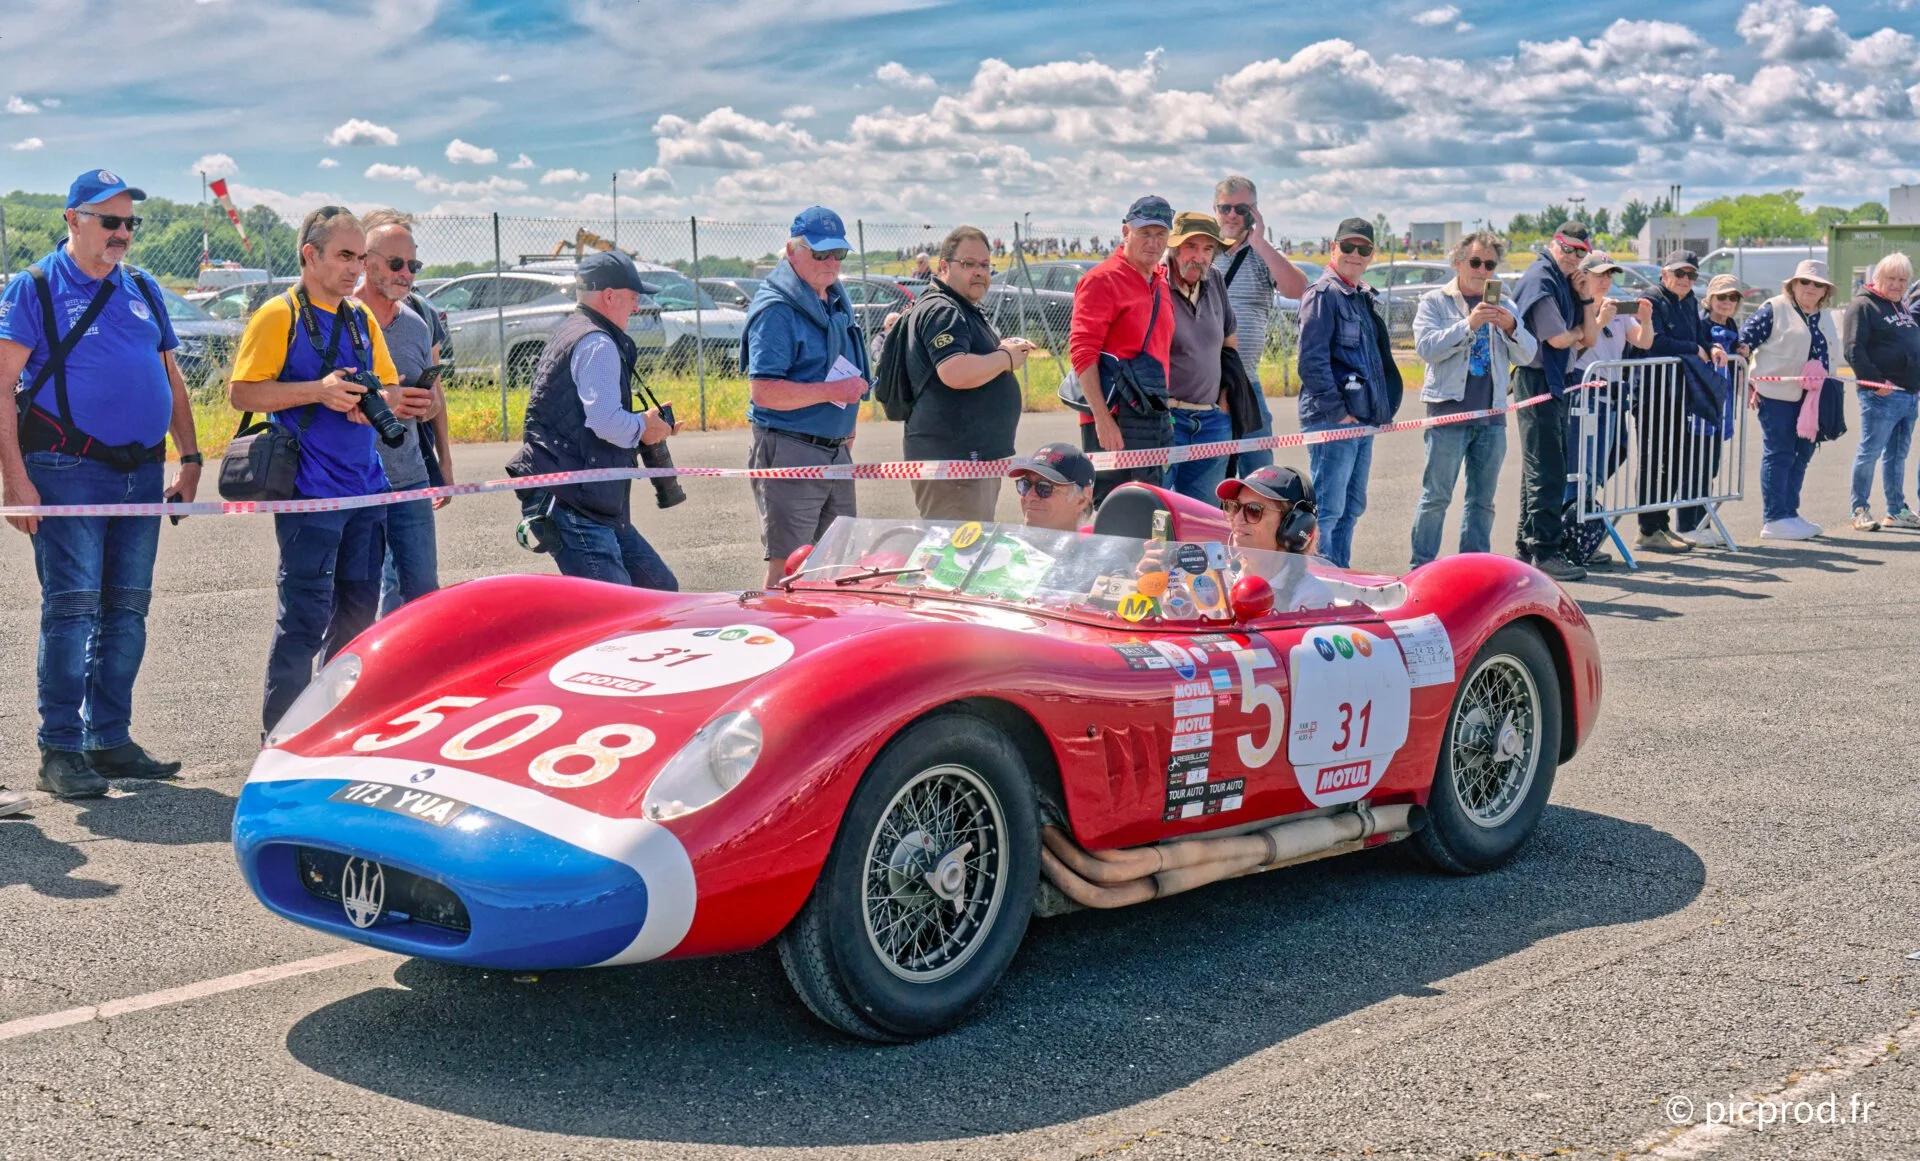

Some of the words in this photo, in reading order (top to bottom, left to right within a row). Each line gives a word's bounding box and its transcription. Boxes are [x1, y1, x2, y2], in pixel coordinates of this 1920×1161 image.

[349, 321, 360, 345] Canon
[936, 335, 951, 347] 63
[955, 526, 978, 545] M
[1123, 598, 1148, 616] M
[628, 647, 712, 668] 31
[574, 673, 648, 691] MOTUL
[1174, 681, 1212, 699] MOTUL
[1174, 715, 1212, 733] MOTUL
[1332, 699, 1372, 752] 31
[352, 695, 656, 788] 508
[1176, 751, 1209, 762] REBELLION
[1209, 783, 1226, 794] TOUR
[1227, 779, 1243, 791] AUTO
[1318, 767, 1369, 791] MOTUL
[1169, 788, 1186, 800] TOUR
[1186, 785, 1204, 797] AUTO
[343, 782, 393, 804] 173
[393, 789, 456, 822] YUA
